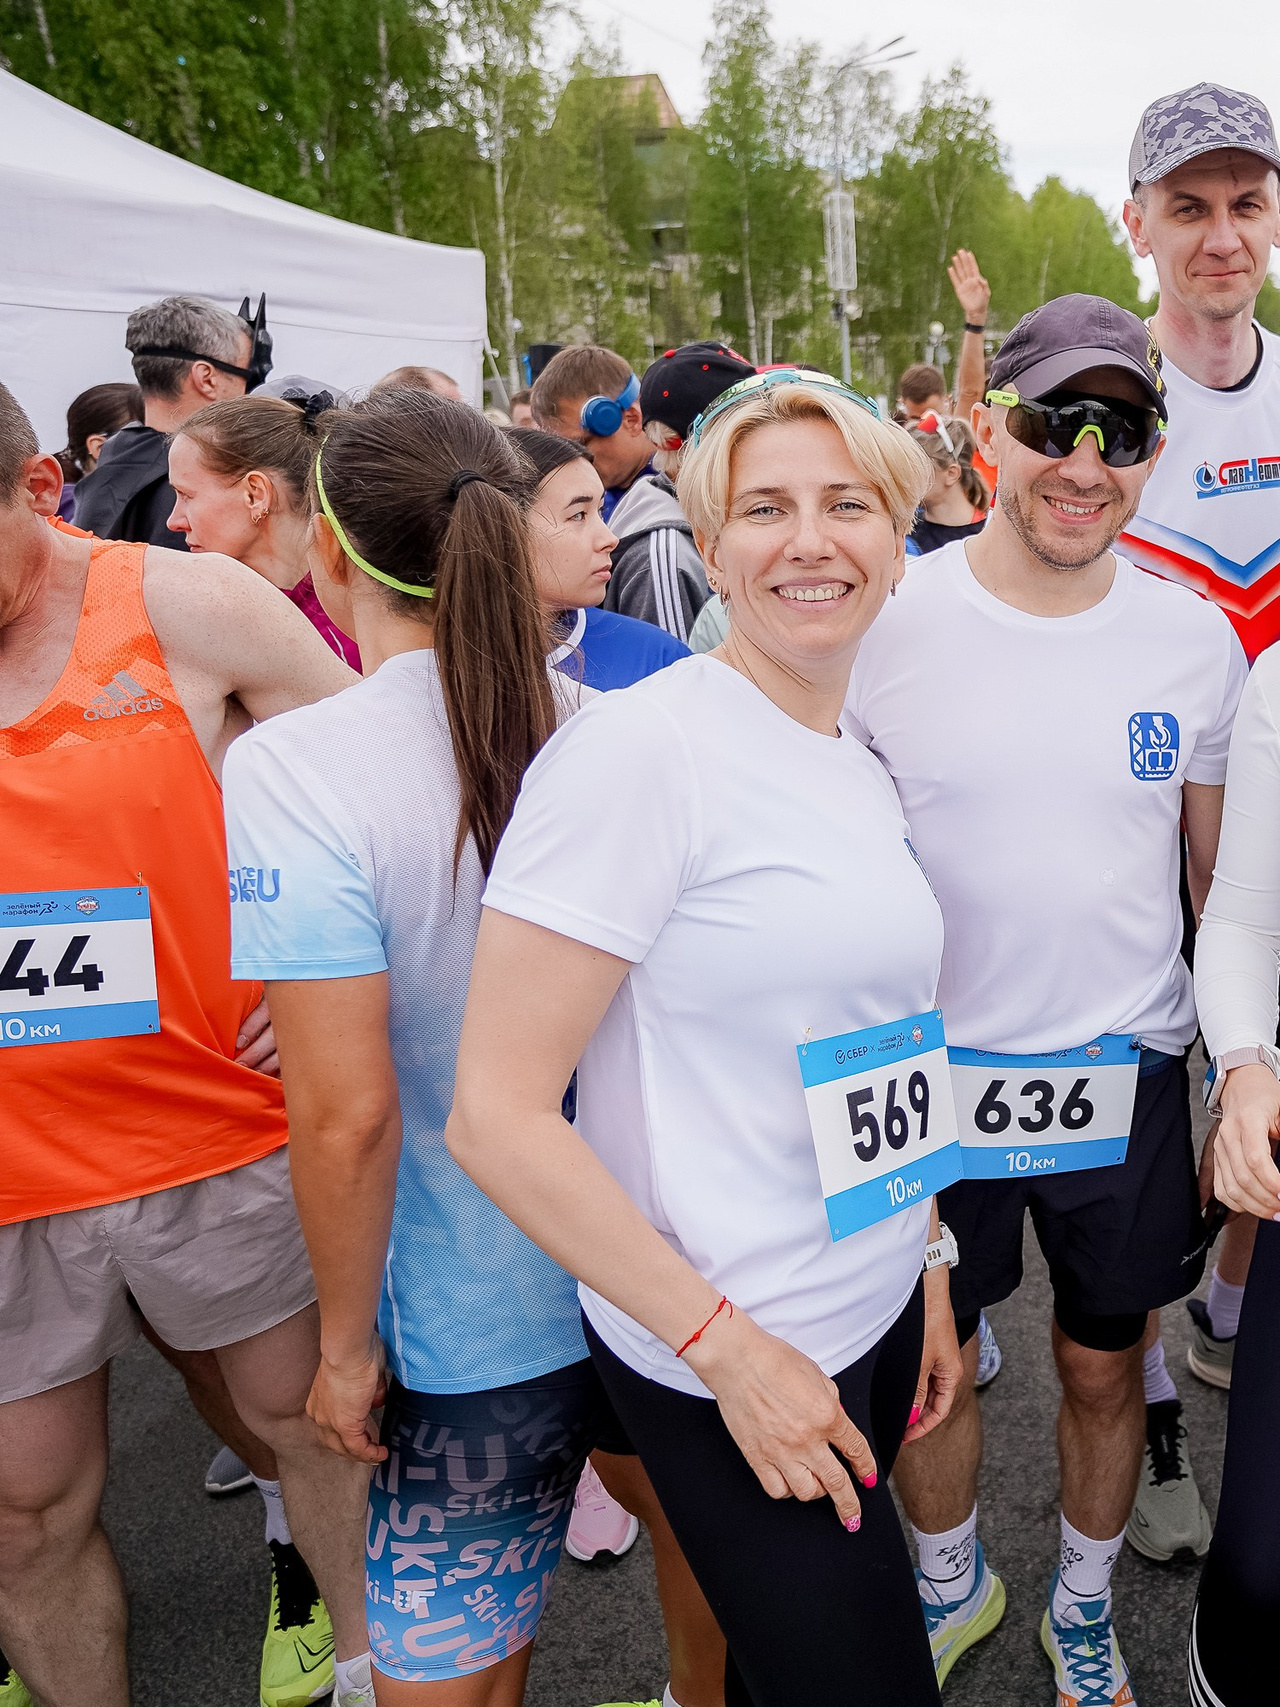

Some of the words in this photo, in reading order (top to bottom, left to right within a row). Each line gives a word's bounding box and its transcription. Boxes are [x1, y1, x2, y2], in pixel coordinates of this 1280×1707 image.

[83, 697, 164, 721] adidas
[2, 908, 39, 917] марафон
[0, 935, 104, 996] 44
[847, 1046, 868, 1060] СБЕР
[846, 1070, 930, 1163] 569
[974, 1077, 1095, 1134] 636
